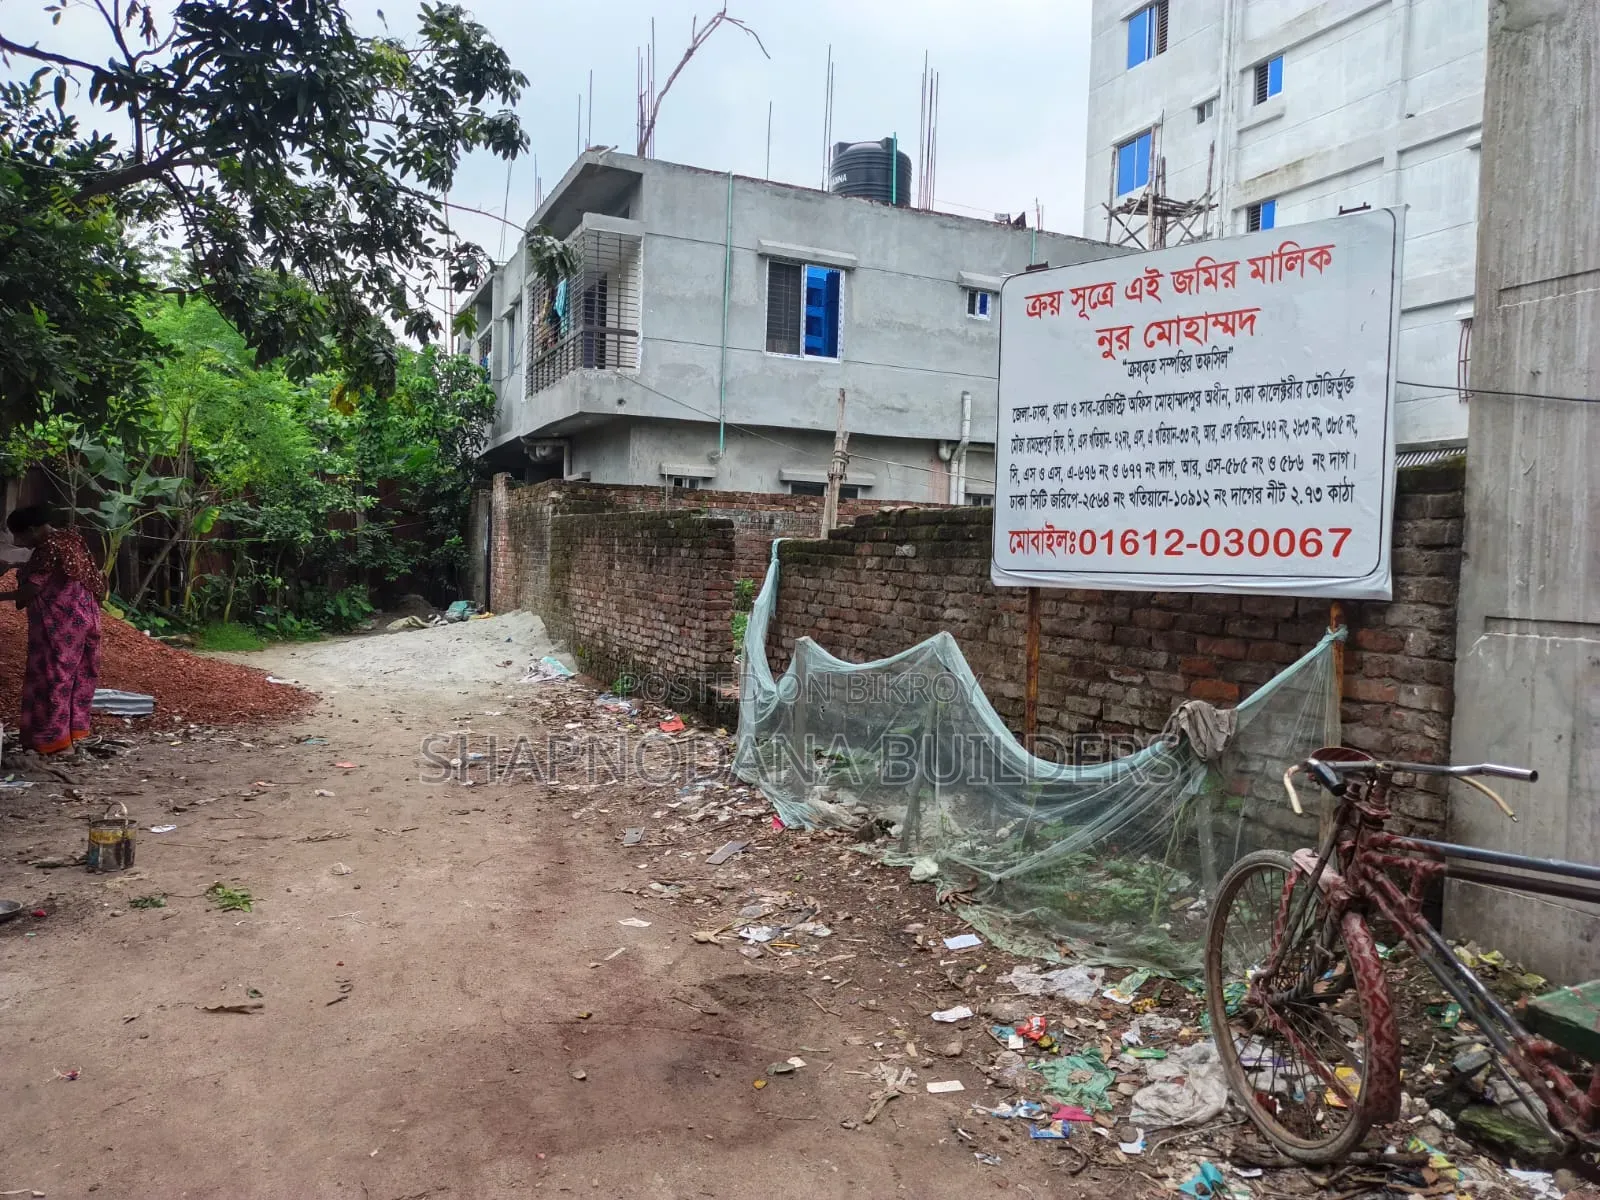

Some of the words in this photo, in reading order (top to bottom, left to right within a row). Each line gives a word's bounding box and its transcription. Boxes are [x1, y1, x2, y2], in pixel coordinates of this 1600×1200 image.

[1024, 290, 1064, 320] ক্রয়
[1070, 281, 1117, 321] সূত্রে
[1125, 266, 1164, 303] এই
[1171, 256, 1240, 296] জমির
[1247, 240, 1336, 285] মালিক
[1095, 325, 1135, 361] নুর
[1143, 307, 1262, 349] মোহাম্মদ
[1053, 401, 1068, 420] থানা
[1071, 402, 1077, 418] ও
[1128, 390, 1153, 414] অফিস
[1154, 390, 1202, 414] মোহাম্মদপুর
[1235, 384, 1255, 406] ঢাকা
[1023, 466, 1036, 484] এস
[1039, 466, 1045, 481] ও
[1099, 464, 1109, 482] নং
[1112, 463, 1118, 479] ও
[1122, 462, 1142, 480] ৬৭৭
[1145, 461, 1156, 480] নং
[1251, 455, 1265, 475] নং
[1268, 455, 1276, 472] ও
[1312, 452, 1326, 473] নং
[1009, 494, 1028, 511] ঢাকা
[1030, 488, 1048, 510] সিটি
[1113, 491, 1126, 510] নং
[1213, 488, 1228, 508] নং
[1230, 485, 1264, 506] দাগের
[1265, 479, 1288, 505] নীট
[1326, 476, 1356, 504] কাঠা
